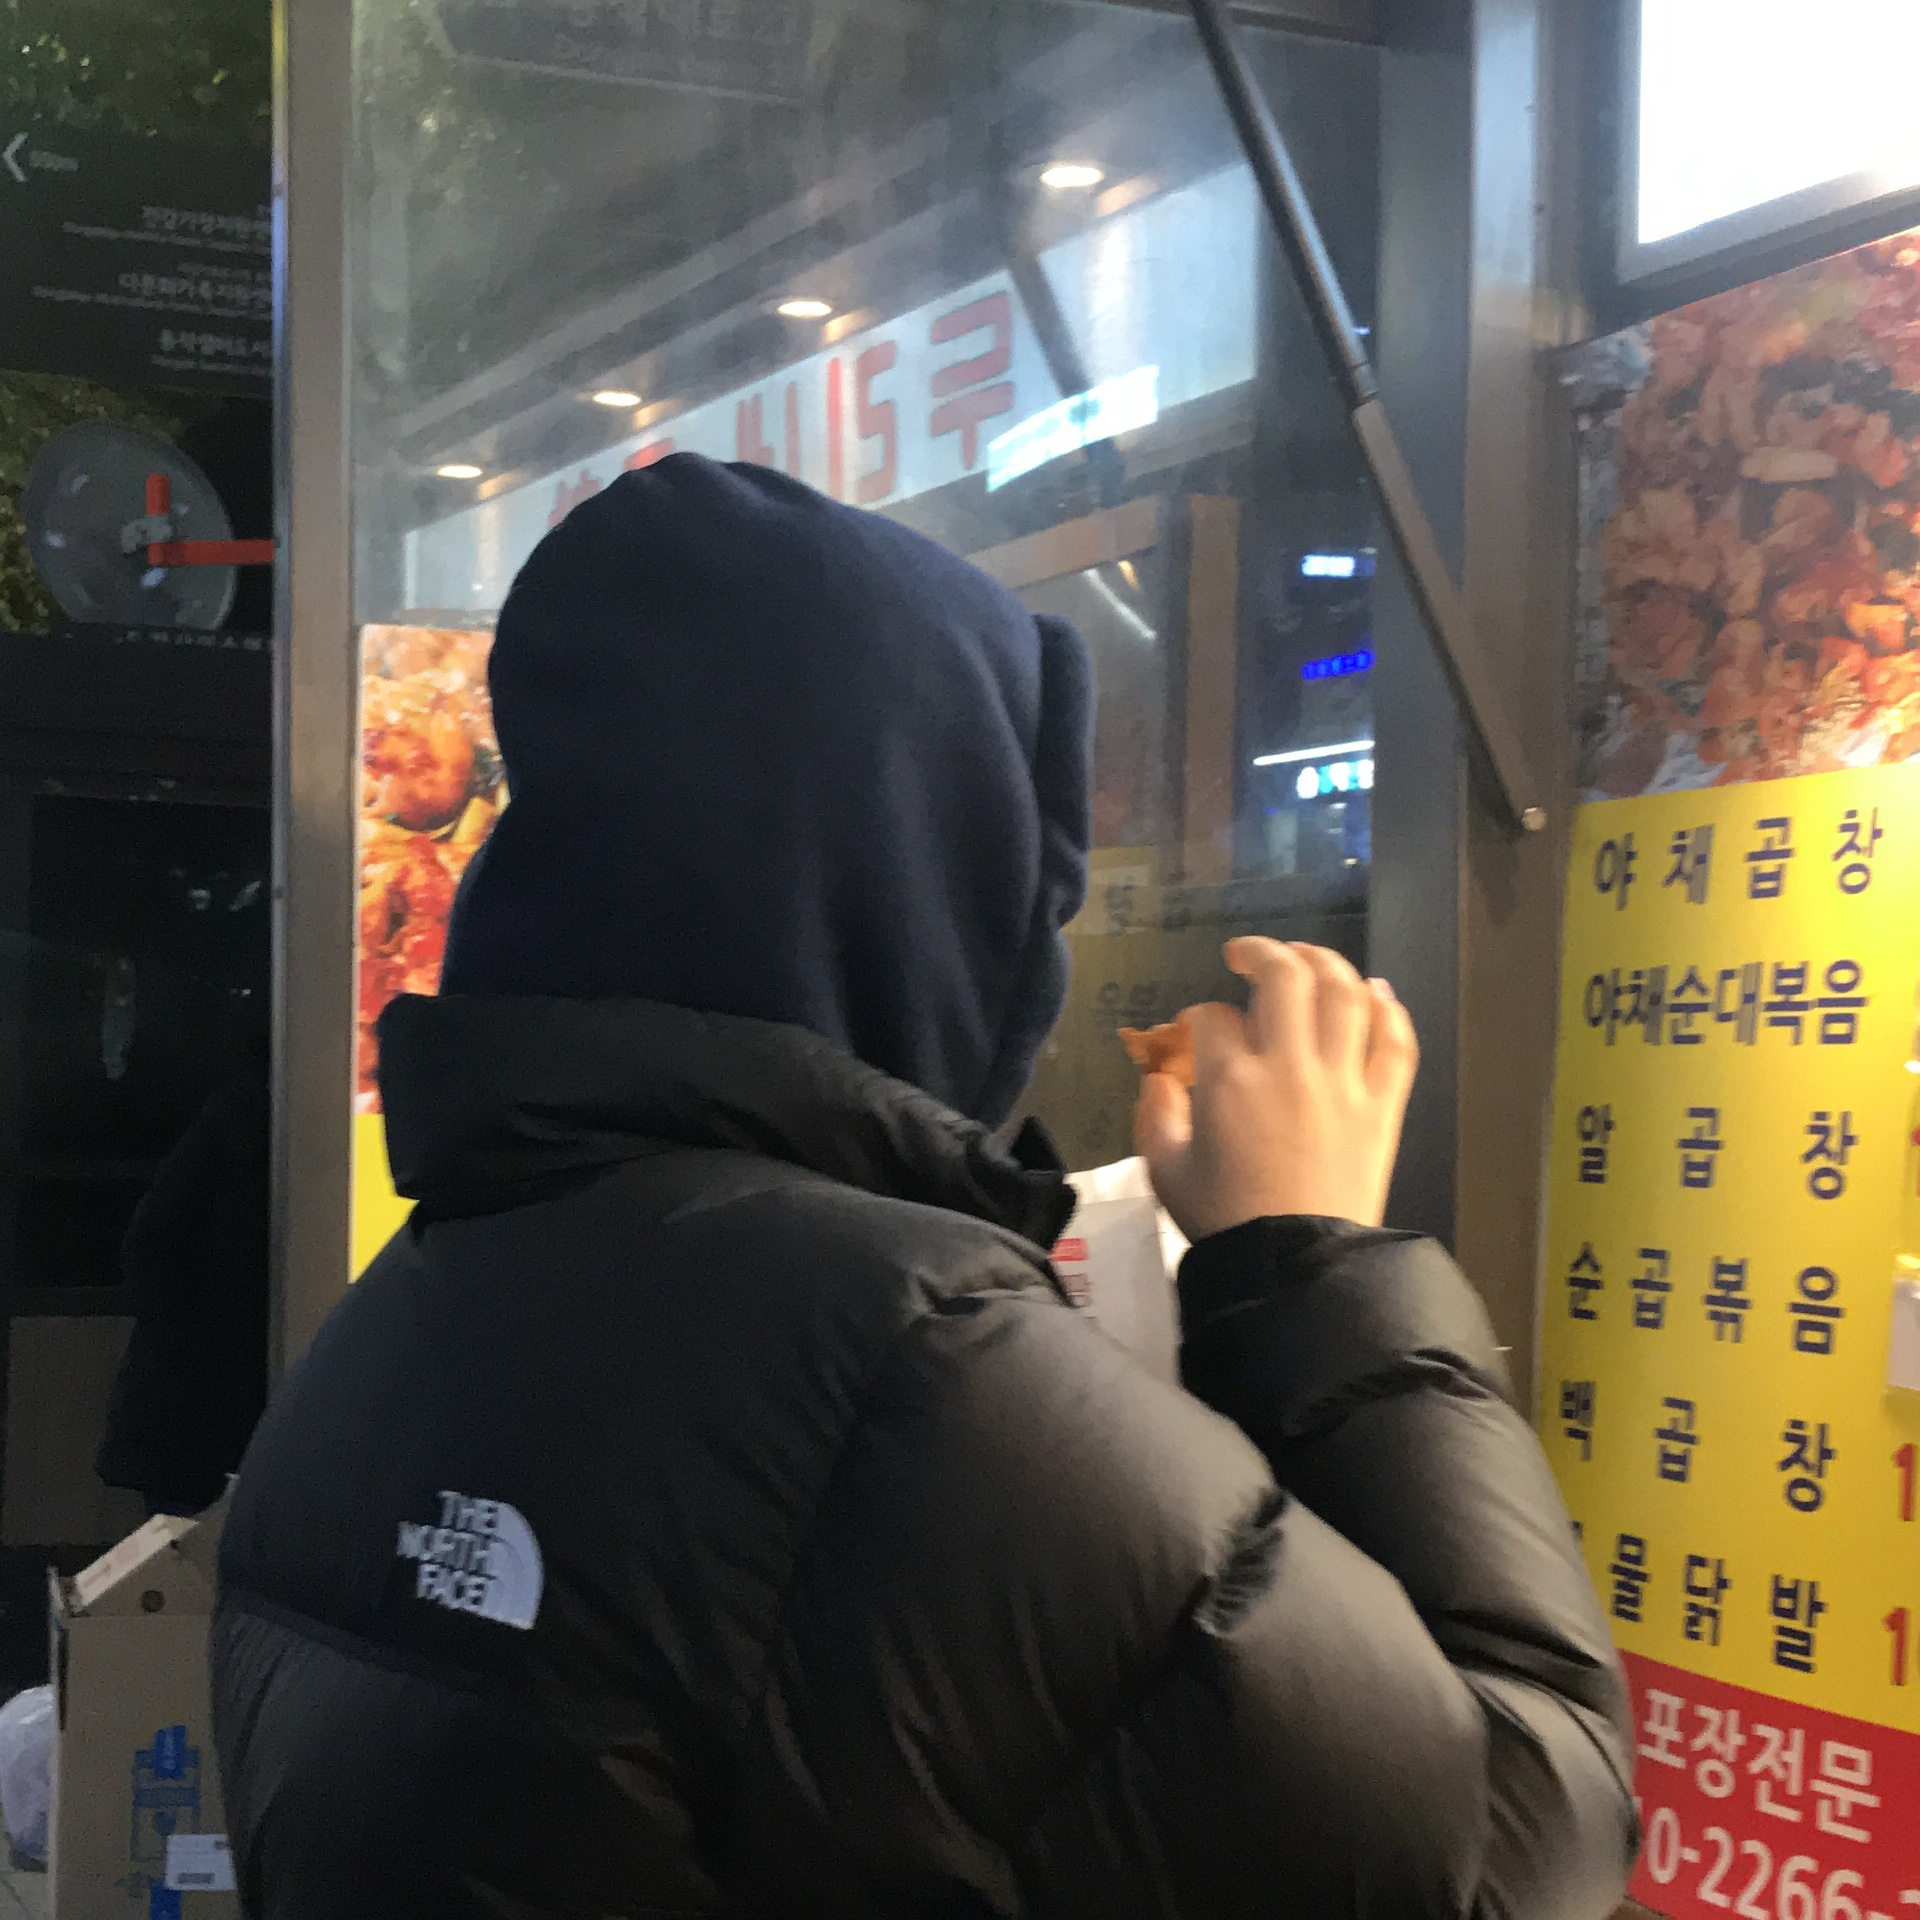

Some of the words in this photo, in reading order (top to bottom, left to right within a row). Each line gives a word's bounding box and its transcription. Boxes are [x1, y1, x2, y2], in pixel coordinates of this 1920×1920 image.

[437, 1490, 500, 1534] THE
[396, 1520, 493, 1577] NORTH
[416, 1563, 489, 1615] FACE
[1636, 1688, 1882, 1844] 포장전문
[1632, 1797, 1920, 1920] 0-2266-
